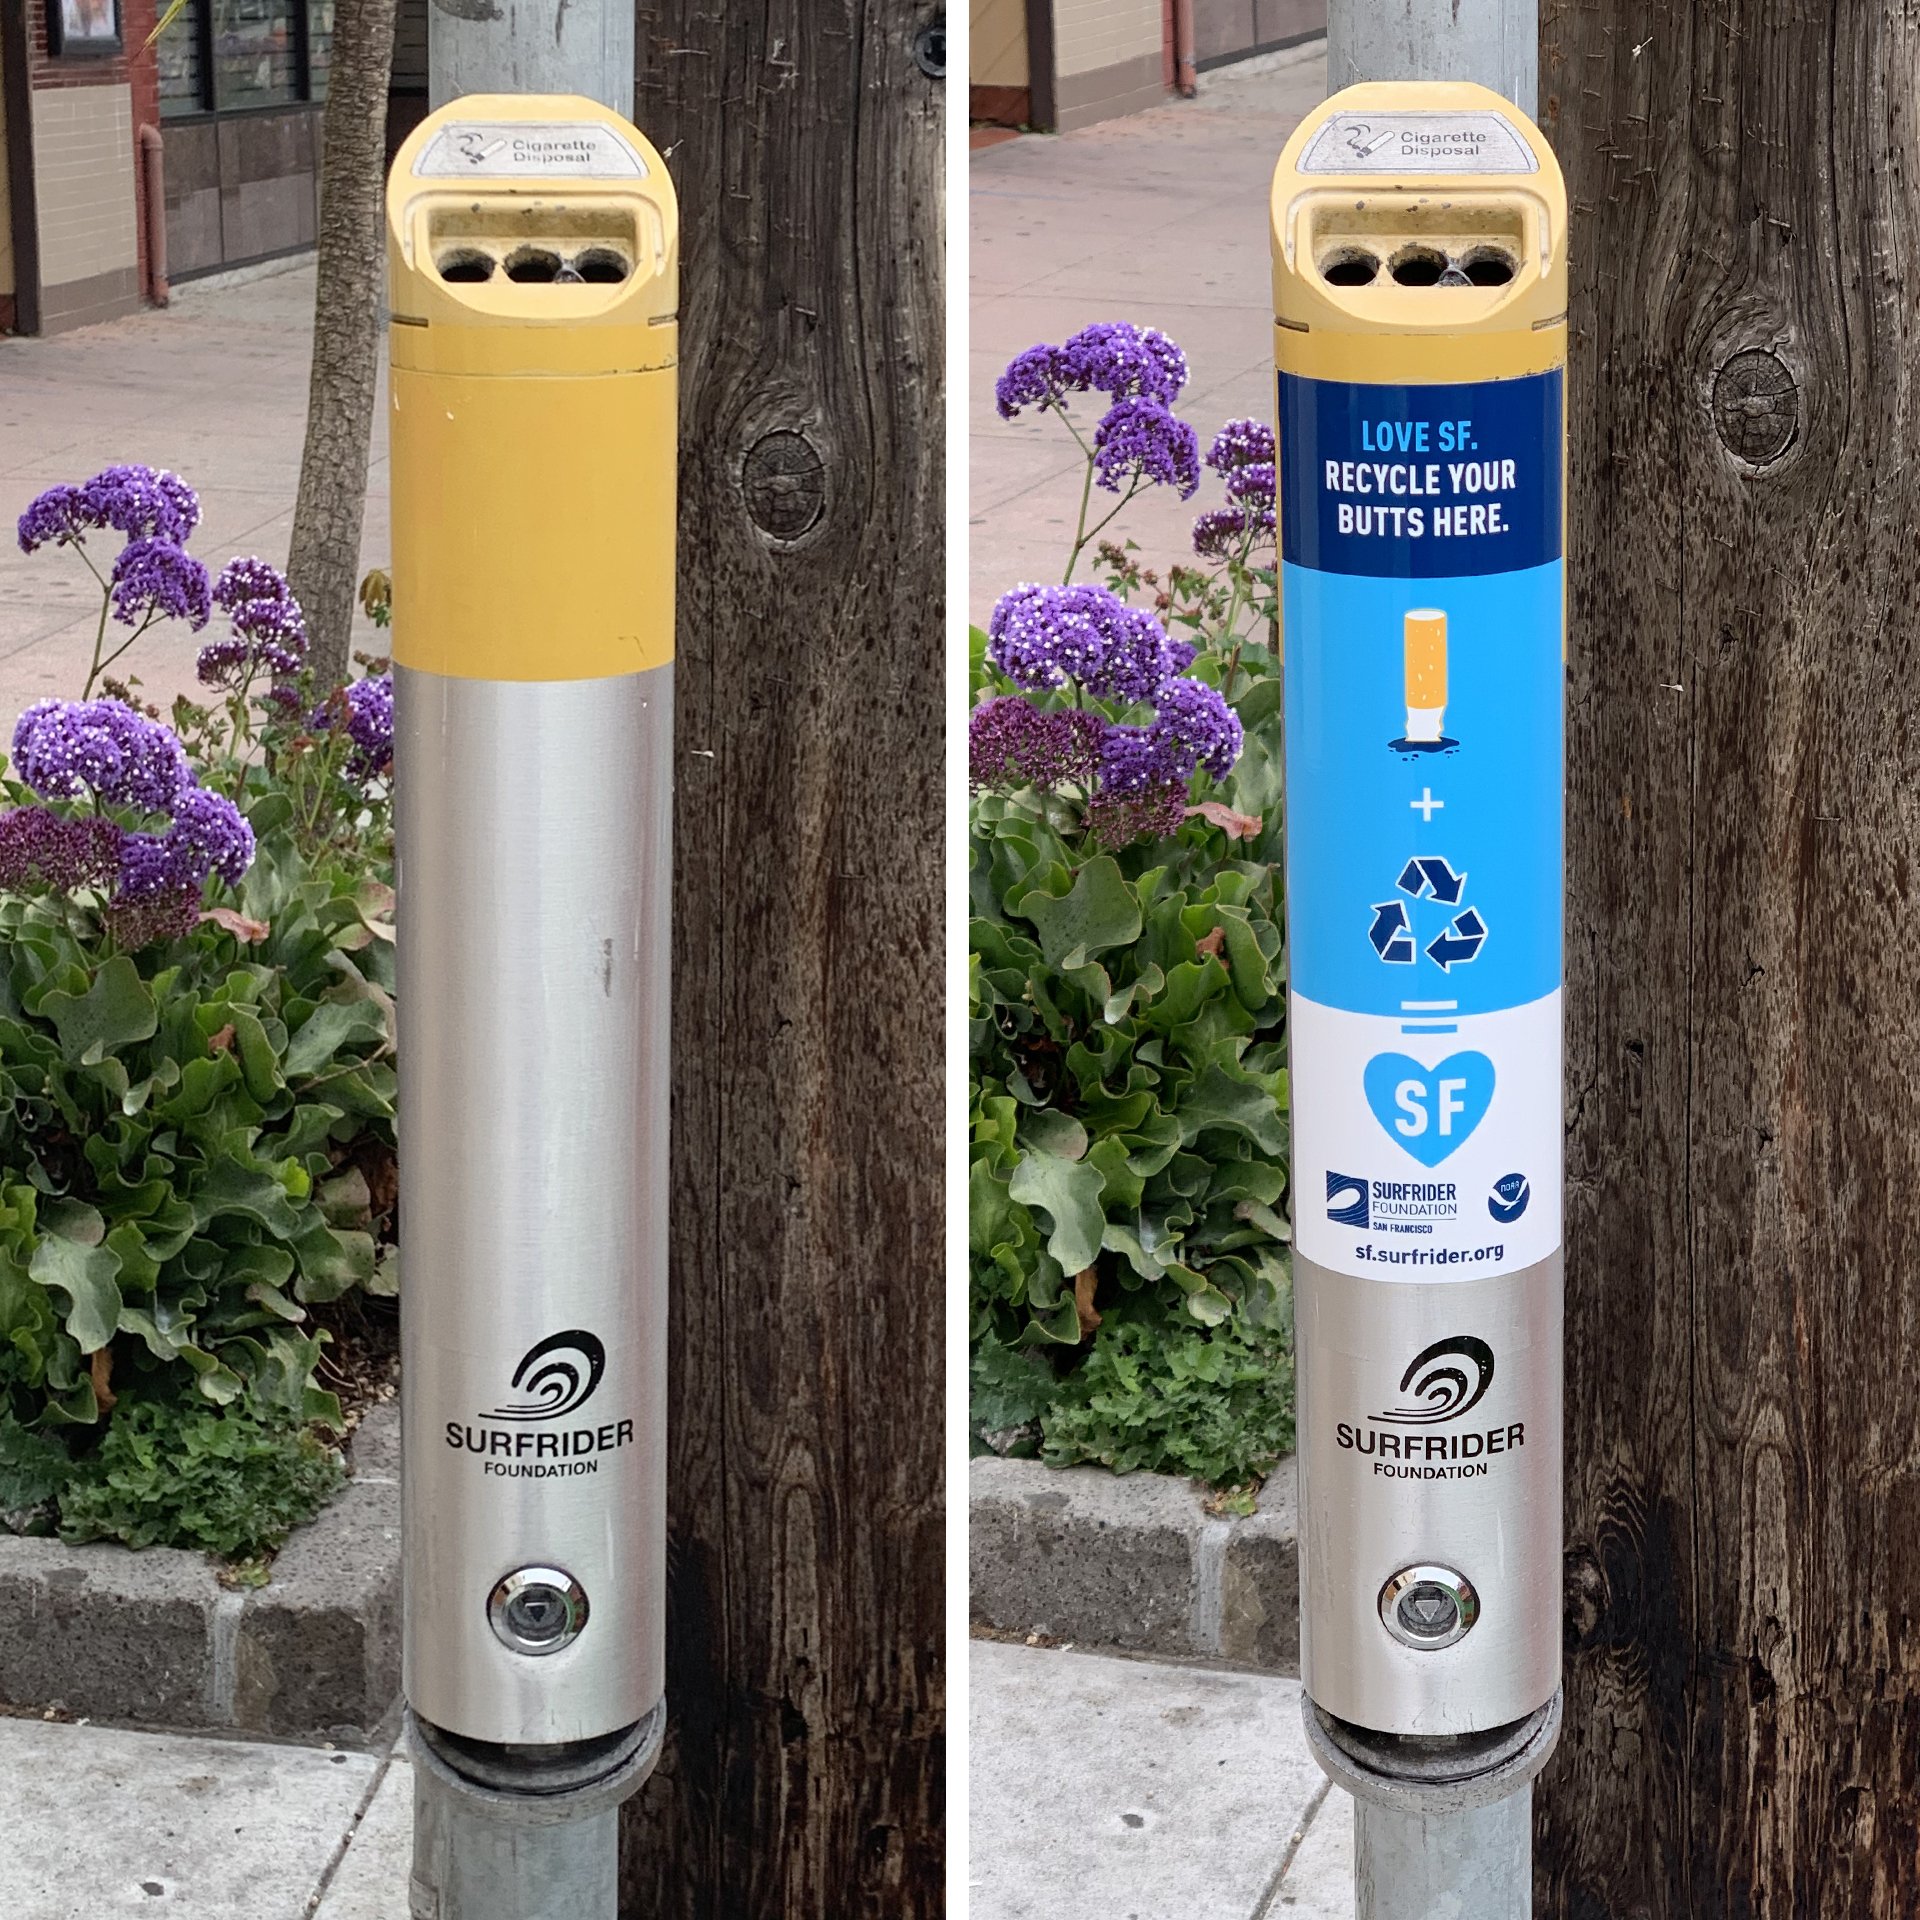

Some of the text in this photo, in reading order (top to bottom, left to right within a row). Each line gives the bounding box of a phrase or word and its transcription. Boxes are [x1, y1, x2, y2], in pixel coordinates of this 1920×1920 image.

[513, 140, 596, 151] Cigarette
[1401, 131, 1486, 144] Cigarette
[514, 152, 590, 163] Disposal
[1401, 145, 1479, 157] Disposal
[1362, 420, 1478, 452] LOVE SF.
[1325, 459, 1516, 495] RECYCLE YOUR
[1338, 503, 1509, 537] BUTTS HERE.
[1394, 1078, 1467, 1137] SF
[1372, 1181, 1456, 1201] SURFRIDER
[1372, 1201, 1457, 1215] FOUNDATION
[1373, 1222, 1433, 1234] SAN FRANCISCO
[1356, 1244, 1504, 1265] sf.surfrider.org
[446, 1419, 634, 1457] SURFRIDER
[1336, 1423, 1525, 1460] SURFRIDER
[484, 1460, 598, 1478] FOUNDATION
[1373, 1463, 1488, 1480] FOUNDATION
